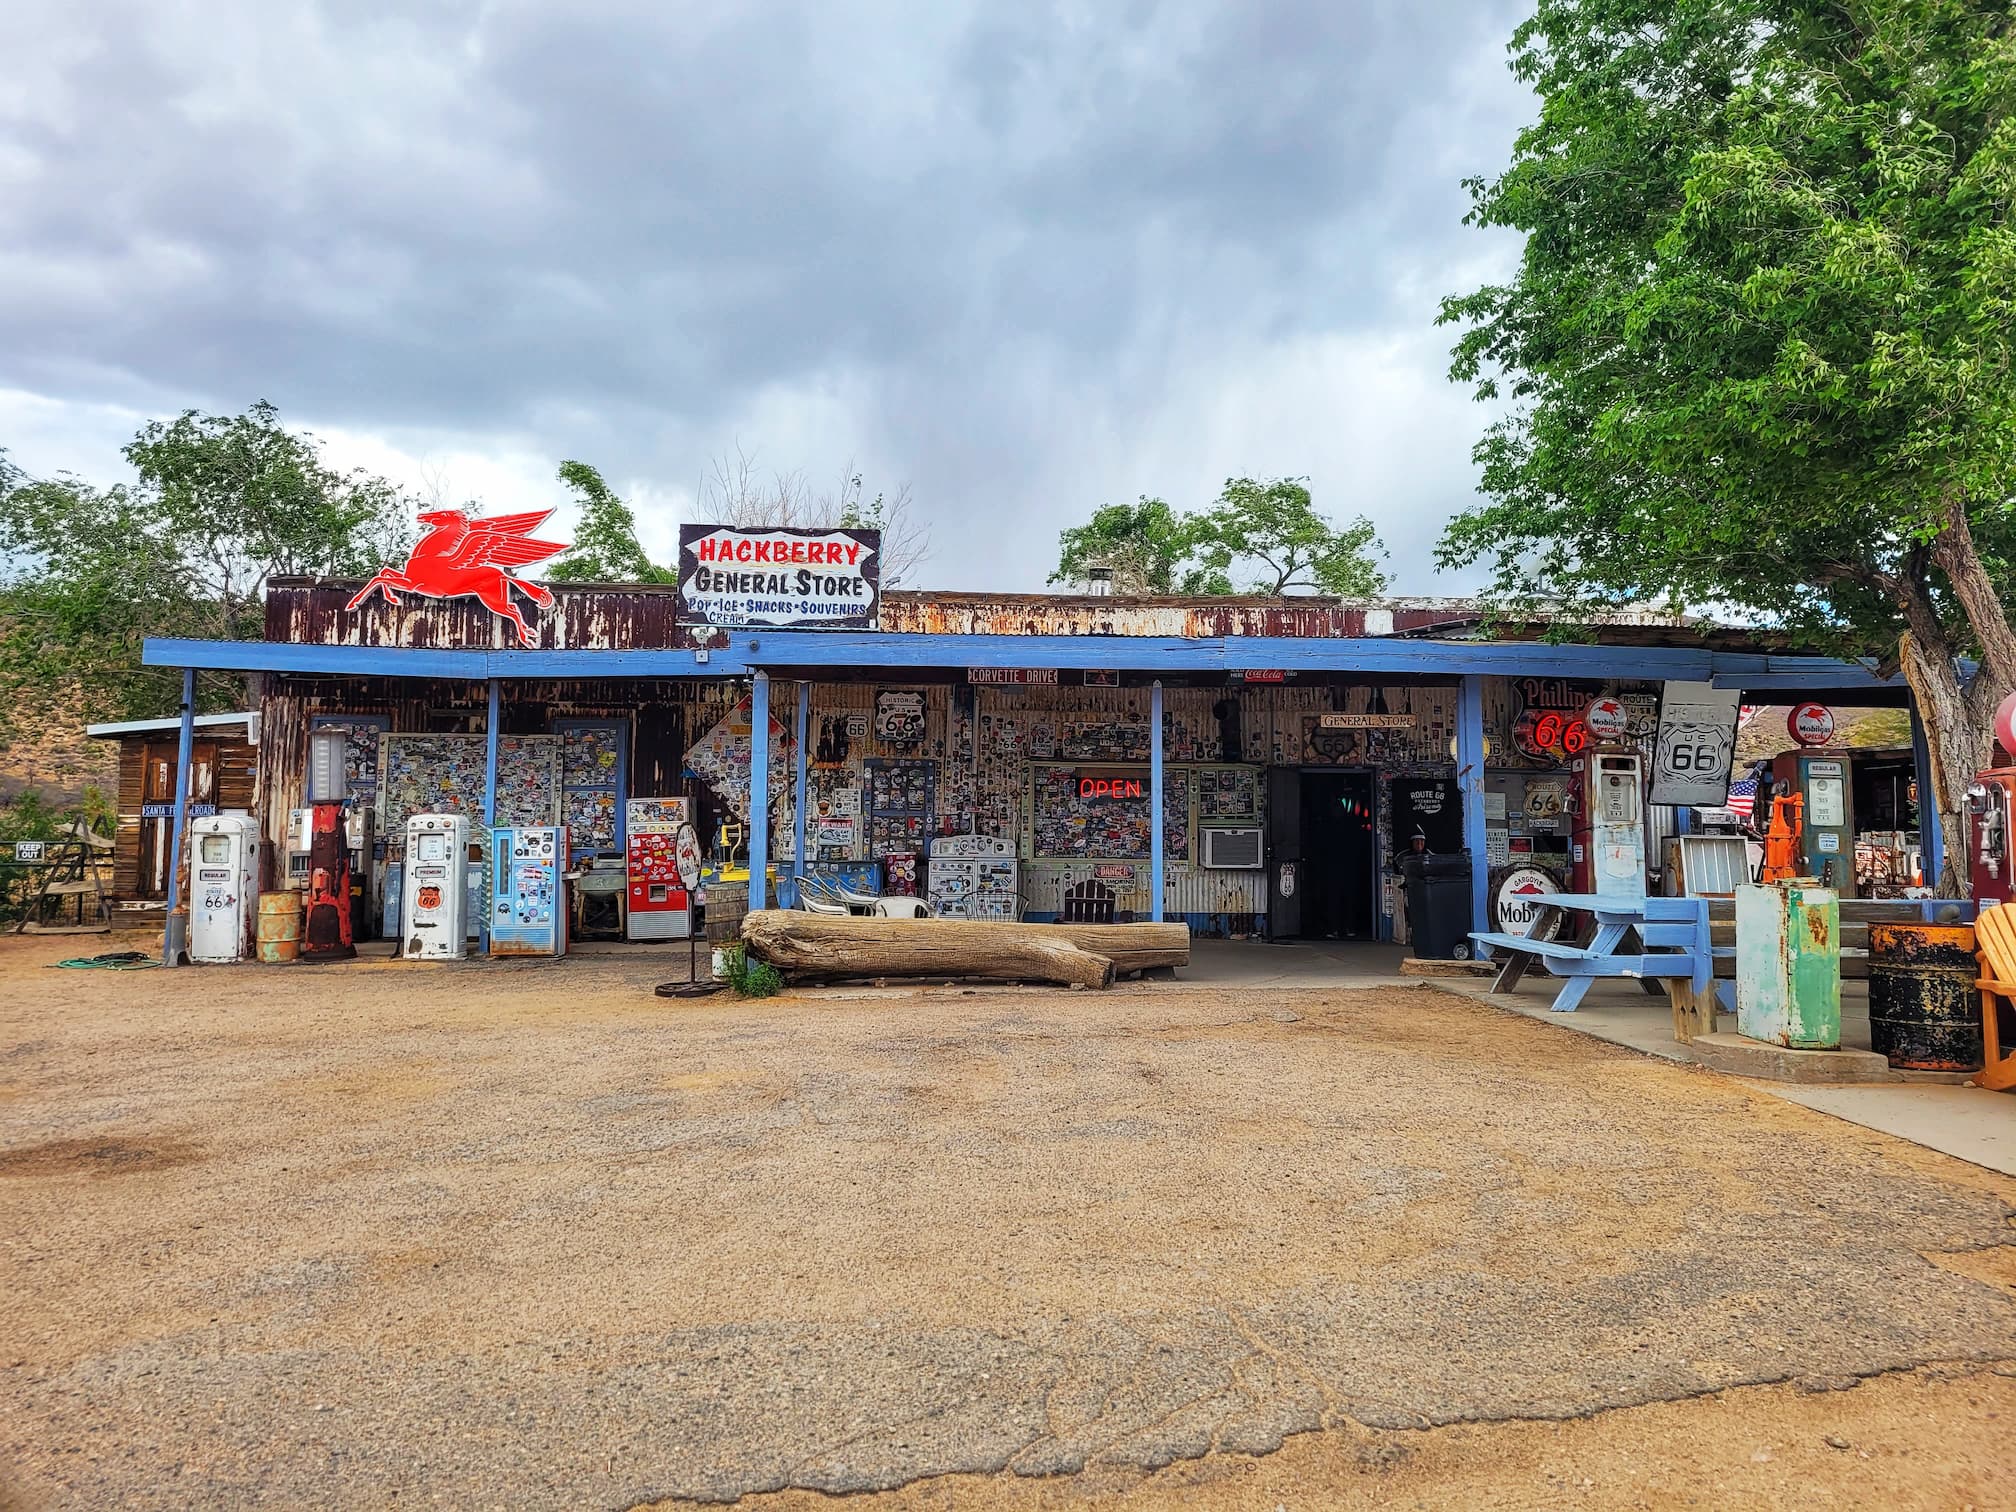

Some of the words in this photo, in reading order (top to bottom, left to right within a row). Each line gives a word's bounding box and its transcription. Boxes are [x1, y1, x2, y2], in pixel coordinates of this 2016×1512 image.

[699, 537, 860, 565] HACKBERRY
[695, 566, 789, 595] GENERAL
[796, 569, 863, 597] STORE
[688, 597, 711, 612] POP
[719, 598, 738, 612] ICE
[746, 599, 792, 614] SNACKS
[800, 601, 866, 615] SOUVENIRS
[709, 612, 744, 624] CREAM
[972, 669, 1019, 682] CORVETTE
[1026, 669, 1053, 682] DRIVE
[1523, 679, 1594, 709] Phillips
[1623, 695, 1655, 704] ROUTE
[886, 714, 915, 732] 66
[1324, 715, 1374, 726] GENERAL
[1378, 715, 1413, 726] STORE
[849, 723, 865, 736] 66
[1535, 713, 1586, 753] 66
[1799, 725, 1831, 734] Mobilgas
[1003, 740, 1017, 749] 66
[1323, 739, 1344, 753] 66
[1672, 744, 1715, 771] 66
[1080, 778, 1141, 799] OPEN
[1410, 790, 1433, 800] ROUTE
[1531, 794, 1559, 811] 66
[145, 805, 165, 816] SANTA
[19, 843, 42, 851] KEEP
[21, 850, 39, 859] OUT
[1100, 865, 1129, 877] DANGER
[1514, 876, 1543, 887] GARGOYLE
[205, 895, 223, 908] 66
[422, 896, 436, 906] 66
[1499, 901, 1535, 923] Mob
